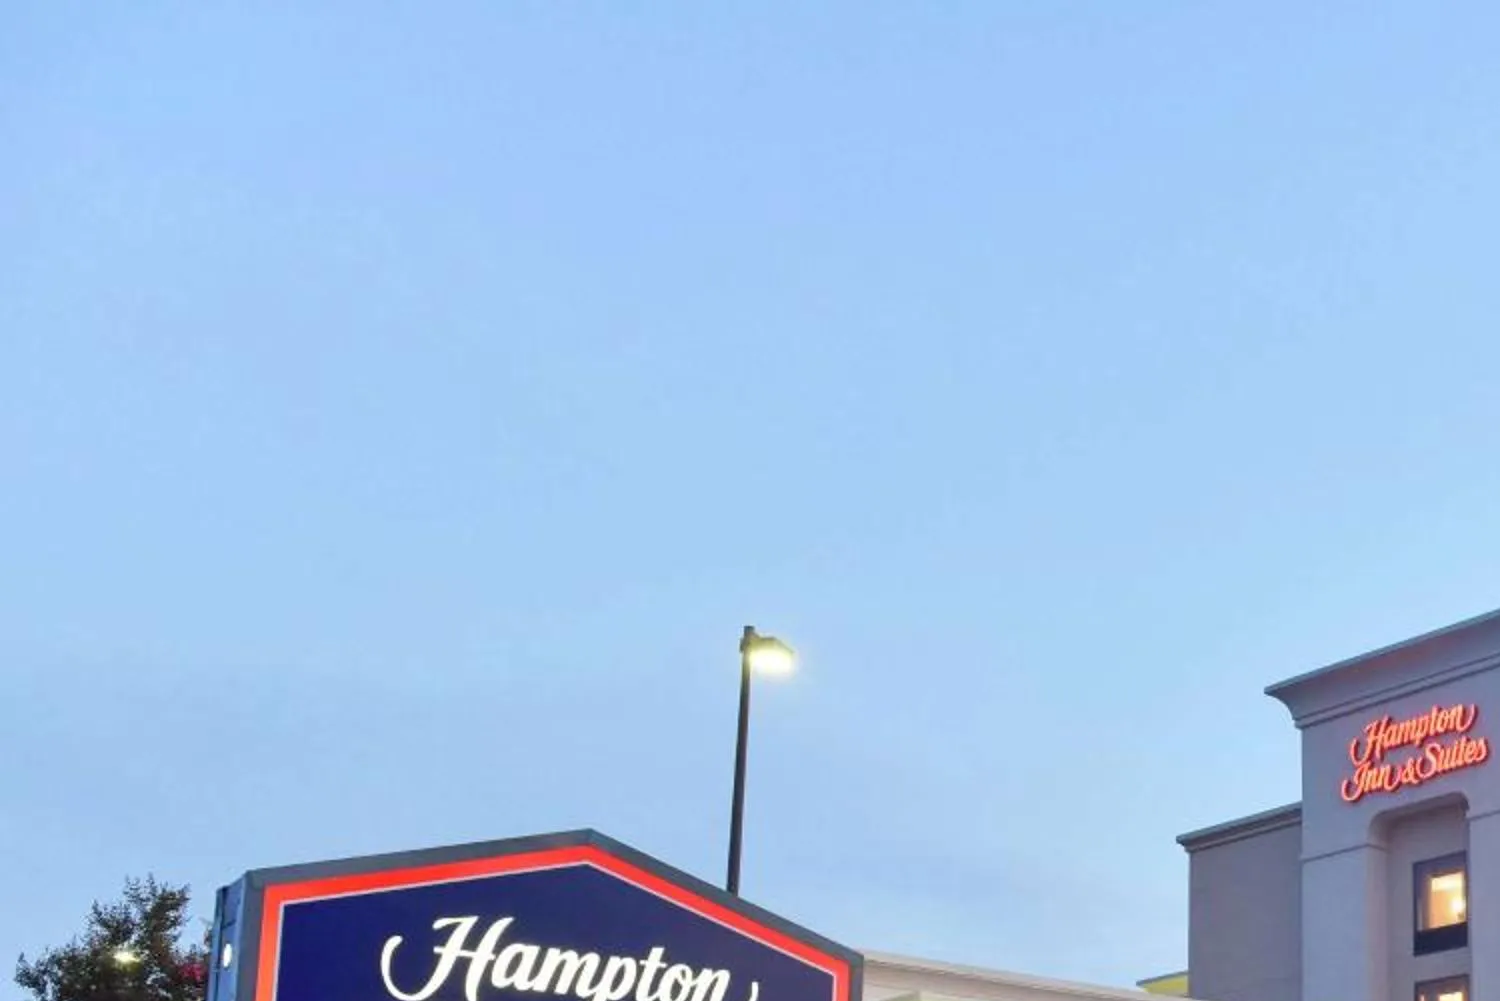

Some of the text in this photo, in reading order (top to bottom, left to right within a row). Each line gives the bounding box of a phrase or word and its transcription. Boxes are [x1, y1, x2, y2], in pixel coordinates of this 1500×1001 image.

[1350, 704, 1477, 766] Hampton
[1341, 736, 1488, 802] Inn & Suites
